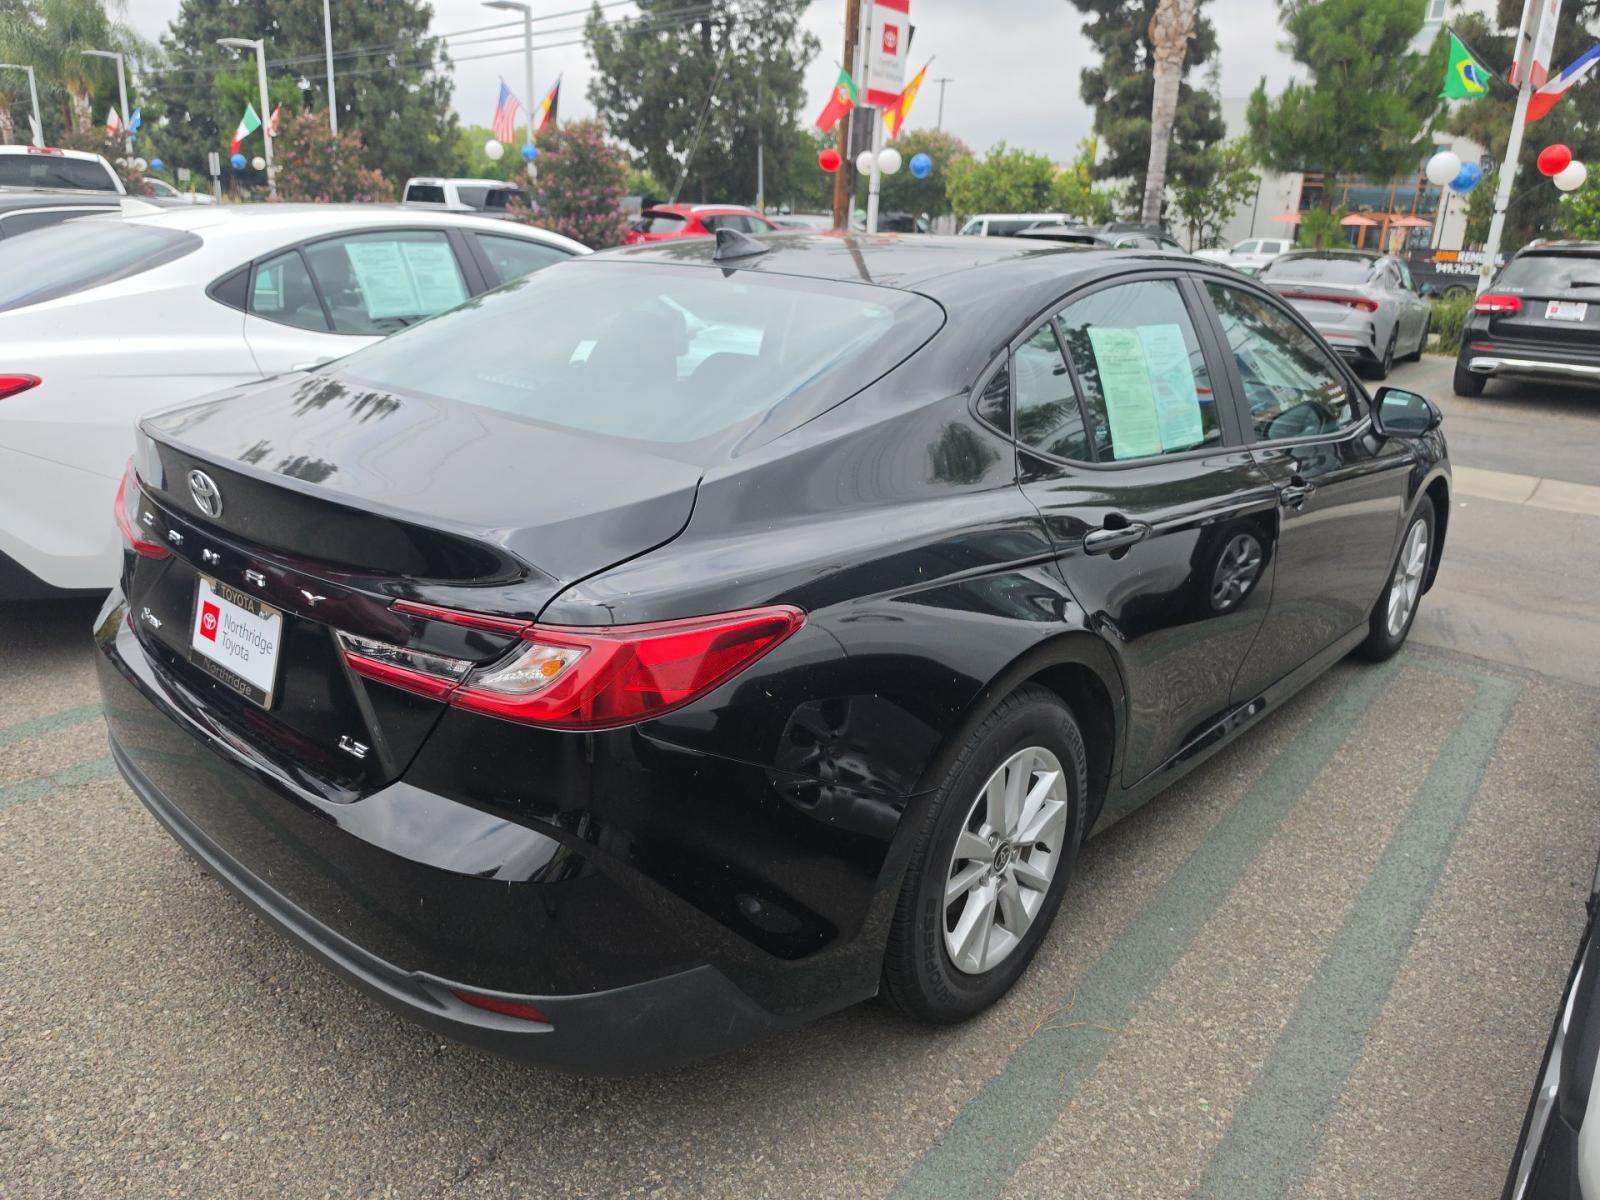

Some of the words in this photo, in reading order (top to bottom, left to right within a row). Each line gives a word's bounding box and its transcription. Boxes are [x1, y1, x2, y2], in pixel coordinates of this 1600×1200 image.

[143, 511, 327, 607] CAMRY
[222, 585, 256, 613] TOYOTA
[221, 631, 250, 662] Toyota
[224, 612, 273, 655] Northridge
[203, 656, 252, 696] Northridge
[339, 735, 369, 759] LE
